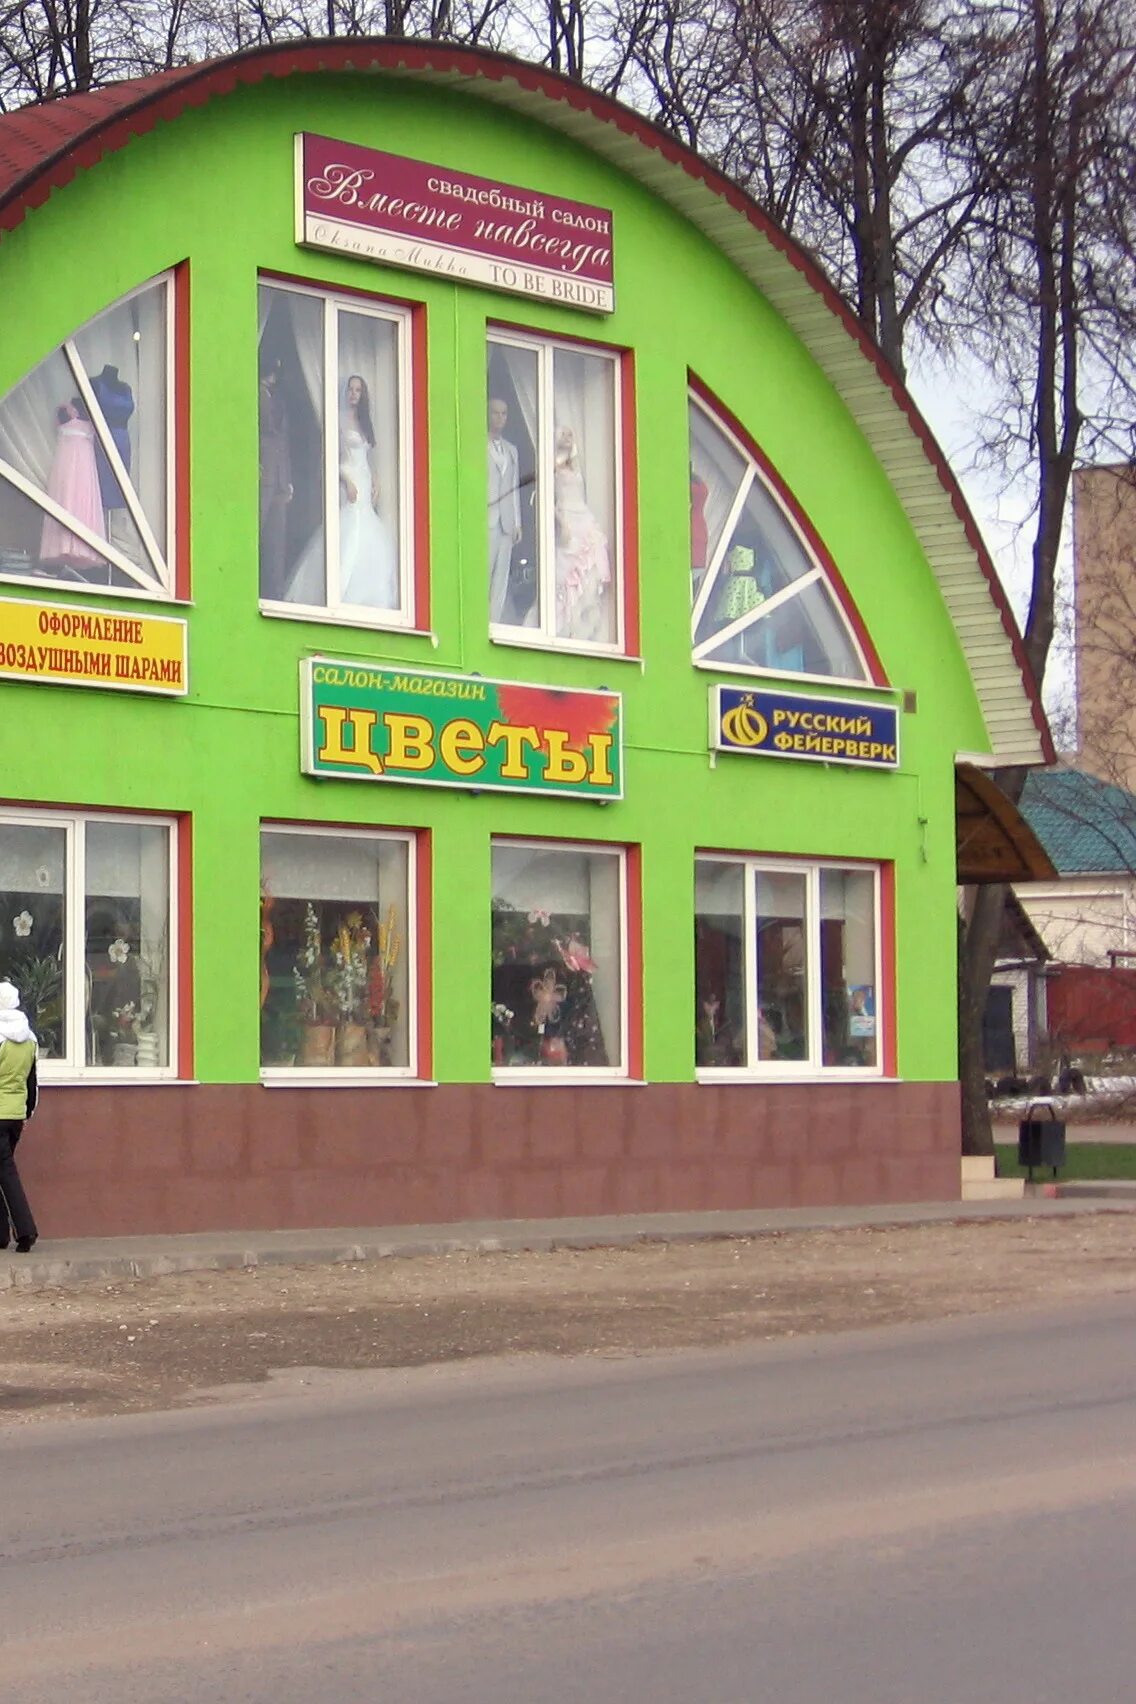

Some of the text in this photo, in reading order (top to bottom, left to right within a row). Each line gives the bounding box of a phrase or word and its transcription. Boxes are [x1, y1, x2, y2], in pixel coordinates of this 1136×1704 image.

[307, 163, 611, 273] Вместе навсегда
[427, 176, 611, 235] свадебный салон
[314, 224, 609, 308] Oksana Mukha TO BE BRIDE
[38, 610, 144, 645] ОФОРМЛЕНИЕ
[115, 655, 183, 683] ШАРАМИ
[313, 665, 487, 701] салон-магазин
[772, 709, 872, 737] РУССКИЙ
[773, 731, 896, 761] ФЕЙЕРВЕРК
